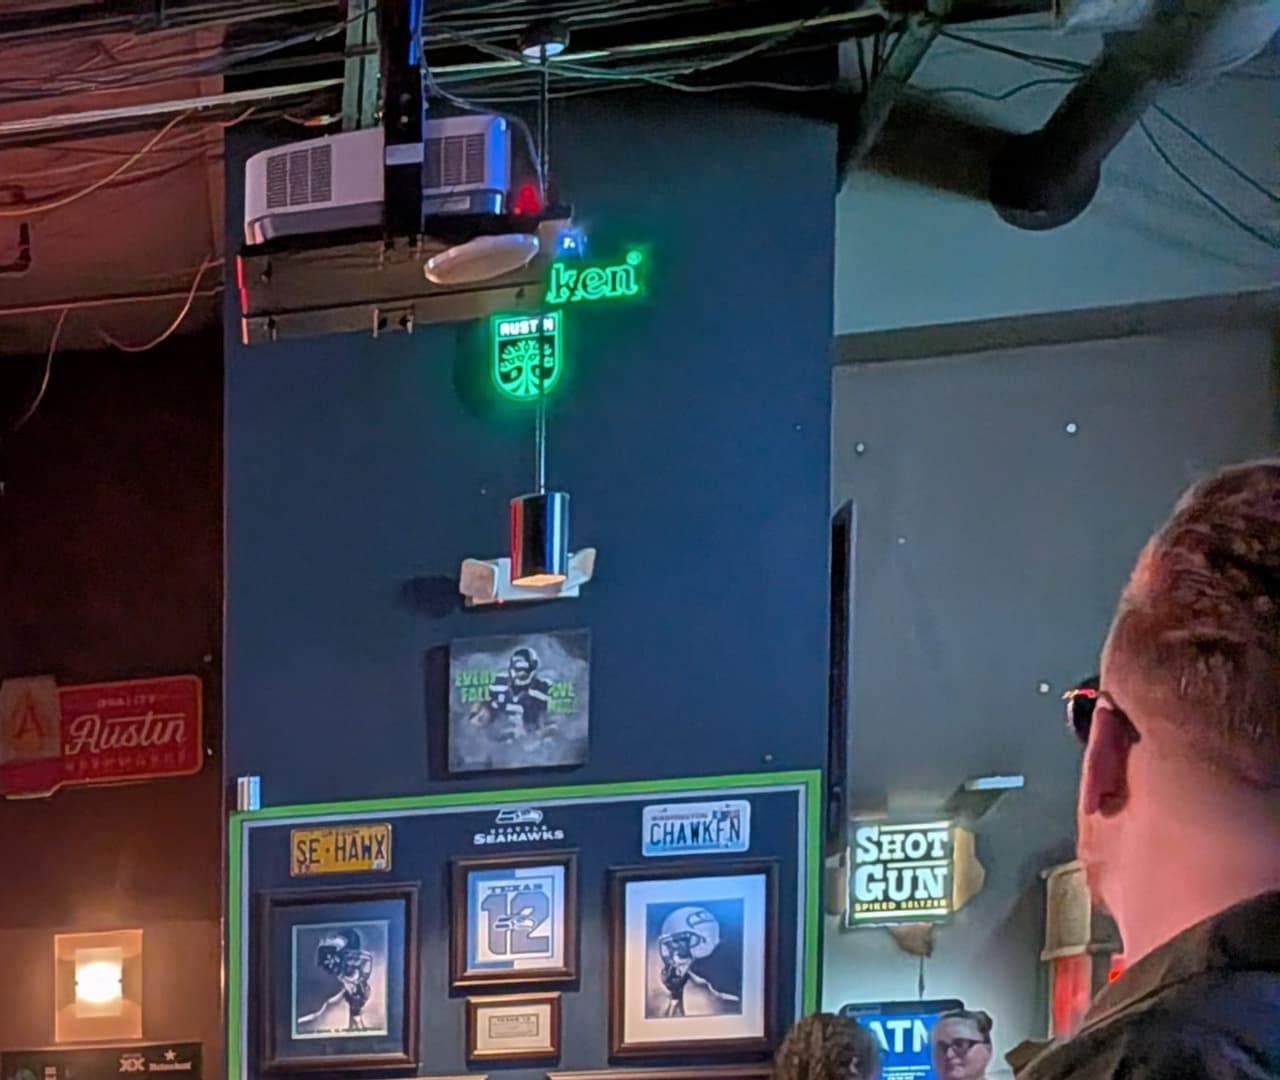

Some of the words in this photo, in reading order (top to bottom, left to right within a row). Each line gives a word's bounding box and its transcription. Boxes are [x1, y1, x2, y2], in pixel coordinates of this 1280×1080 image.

[500, 317, 554, 336] AUSTN
[65, 711, 187, 756] Austin
[473, 829, 565, 845] SEAHAWKS
[856, 826, 948, 864] SHOT
[488, 883, 544, 894] TEXAS
[855, 863, 948, 902] GUN
[854, 901, 897, 912] SPIKED
[900, 898, 948, 910] SELTZER
[481, 891, 550, 956] 12
